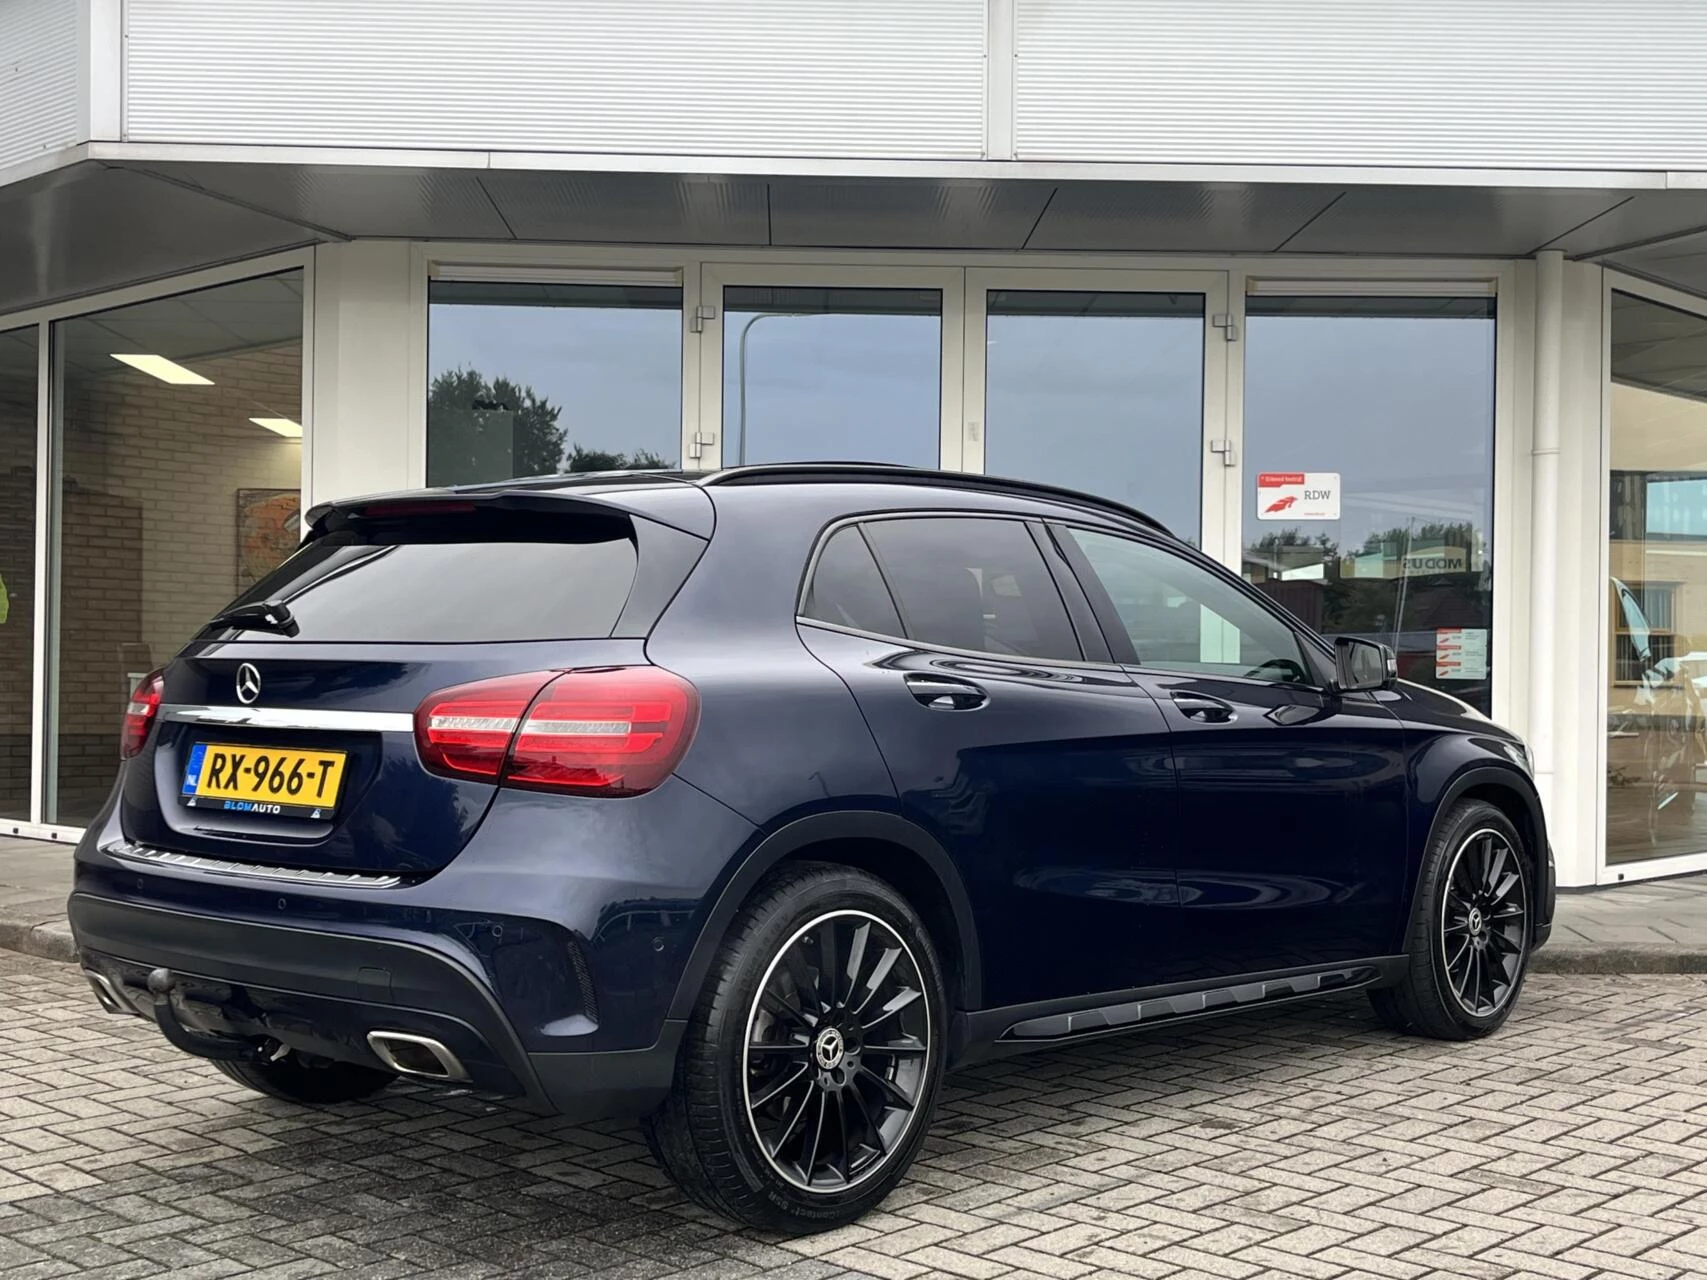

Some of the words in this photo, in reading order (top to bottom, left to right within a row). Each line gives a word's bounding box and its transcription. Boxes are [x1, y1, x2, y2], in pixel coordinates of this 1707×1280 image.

[1304, 490, 1331, 500] RDW
[186, 774, 197, 786] NL
[206, 752, 336, 798] RX-966-T
